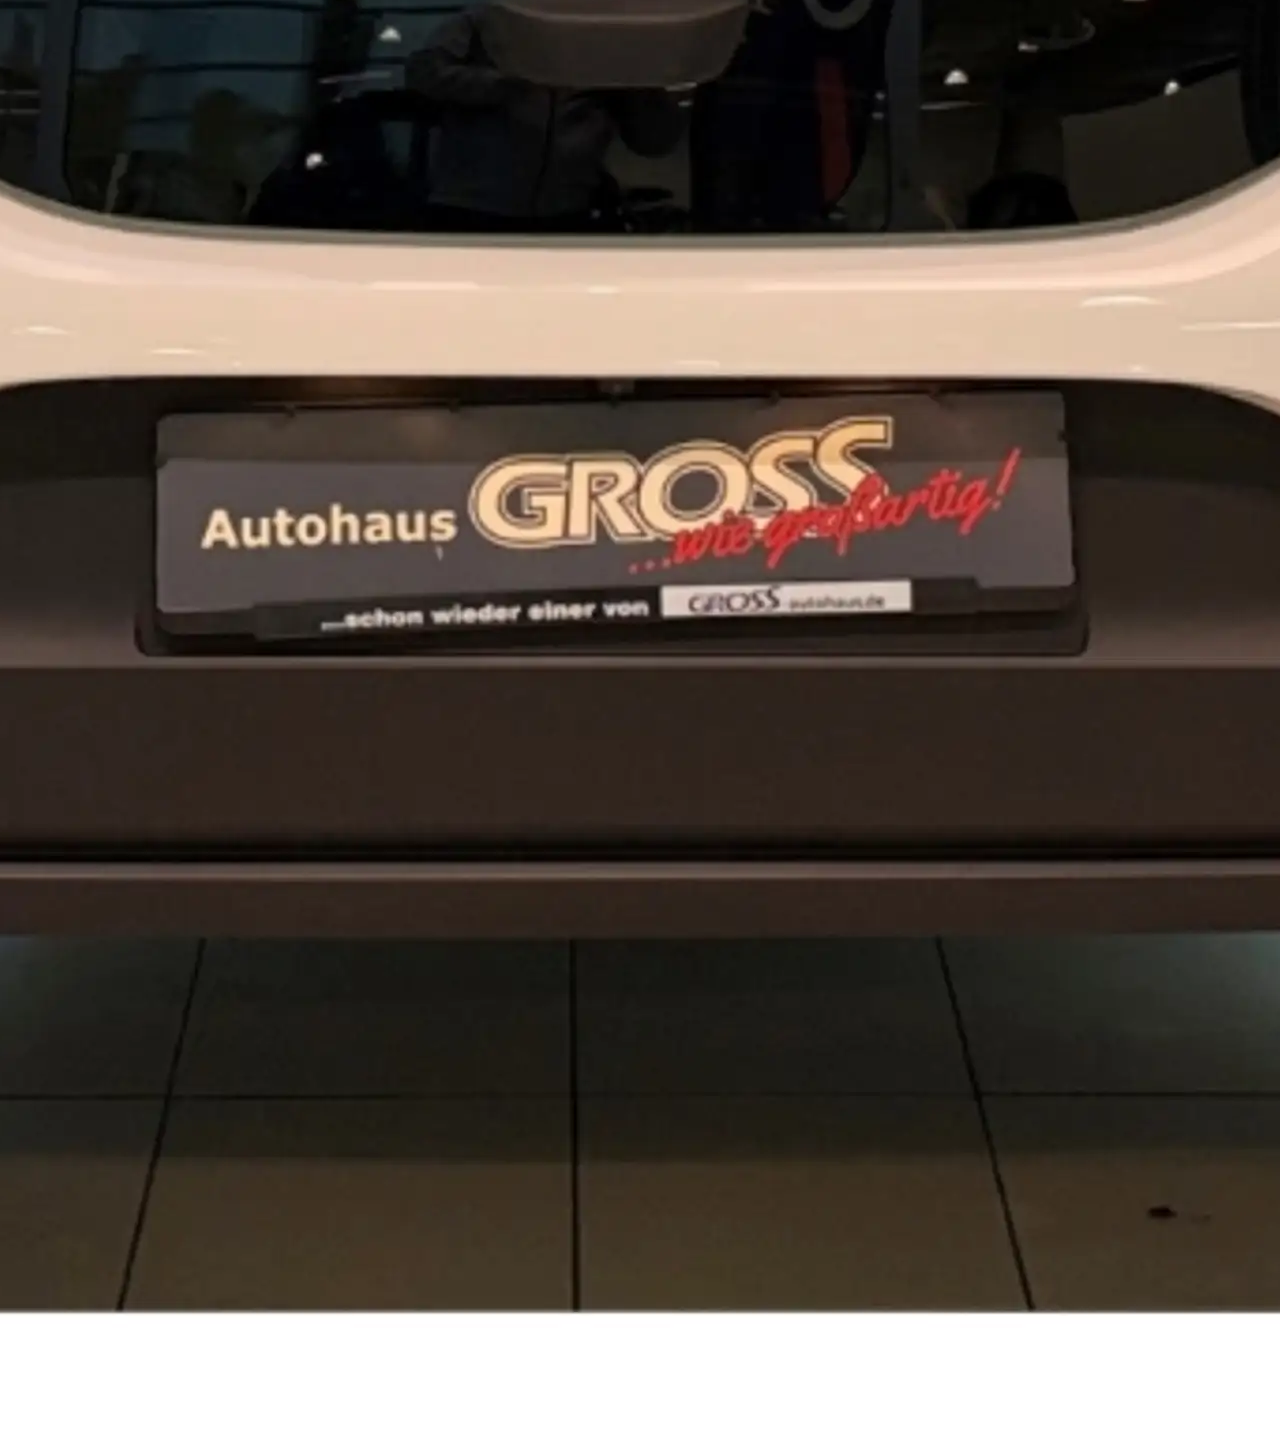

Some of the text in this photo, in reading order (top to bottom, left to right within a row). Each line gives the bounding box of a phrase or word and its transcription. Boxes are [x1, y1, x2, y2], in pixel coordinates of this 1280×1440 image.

[199, 415, 894, 550] Autohaus GROSS
[430, 603, 523, 625] wieder
[527, 600, 597, 620] einer
[602, 598, 650, 618] von
[687, 584, 782, 614] GROSS
